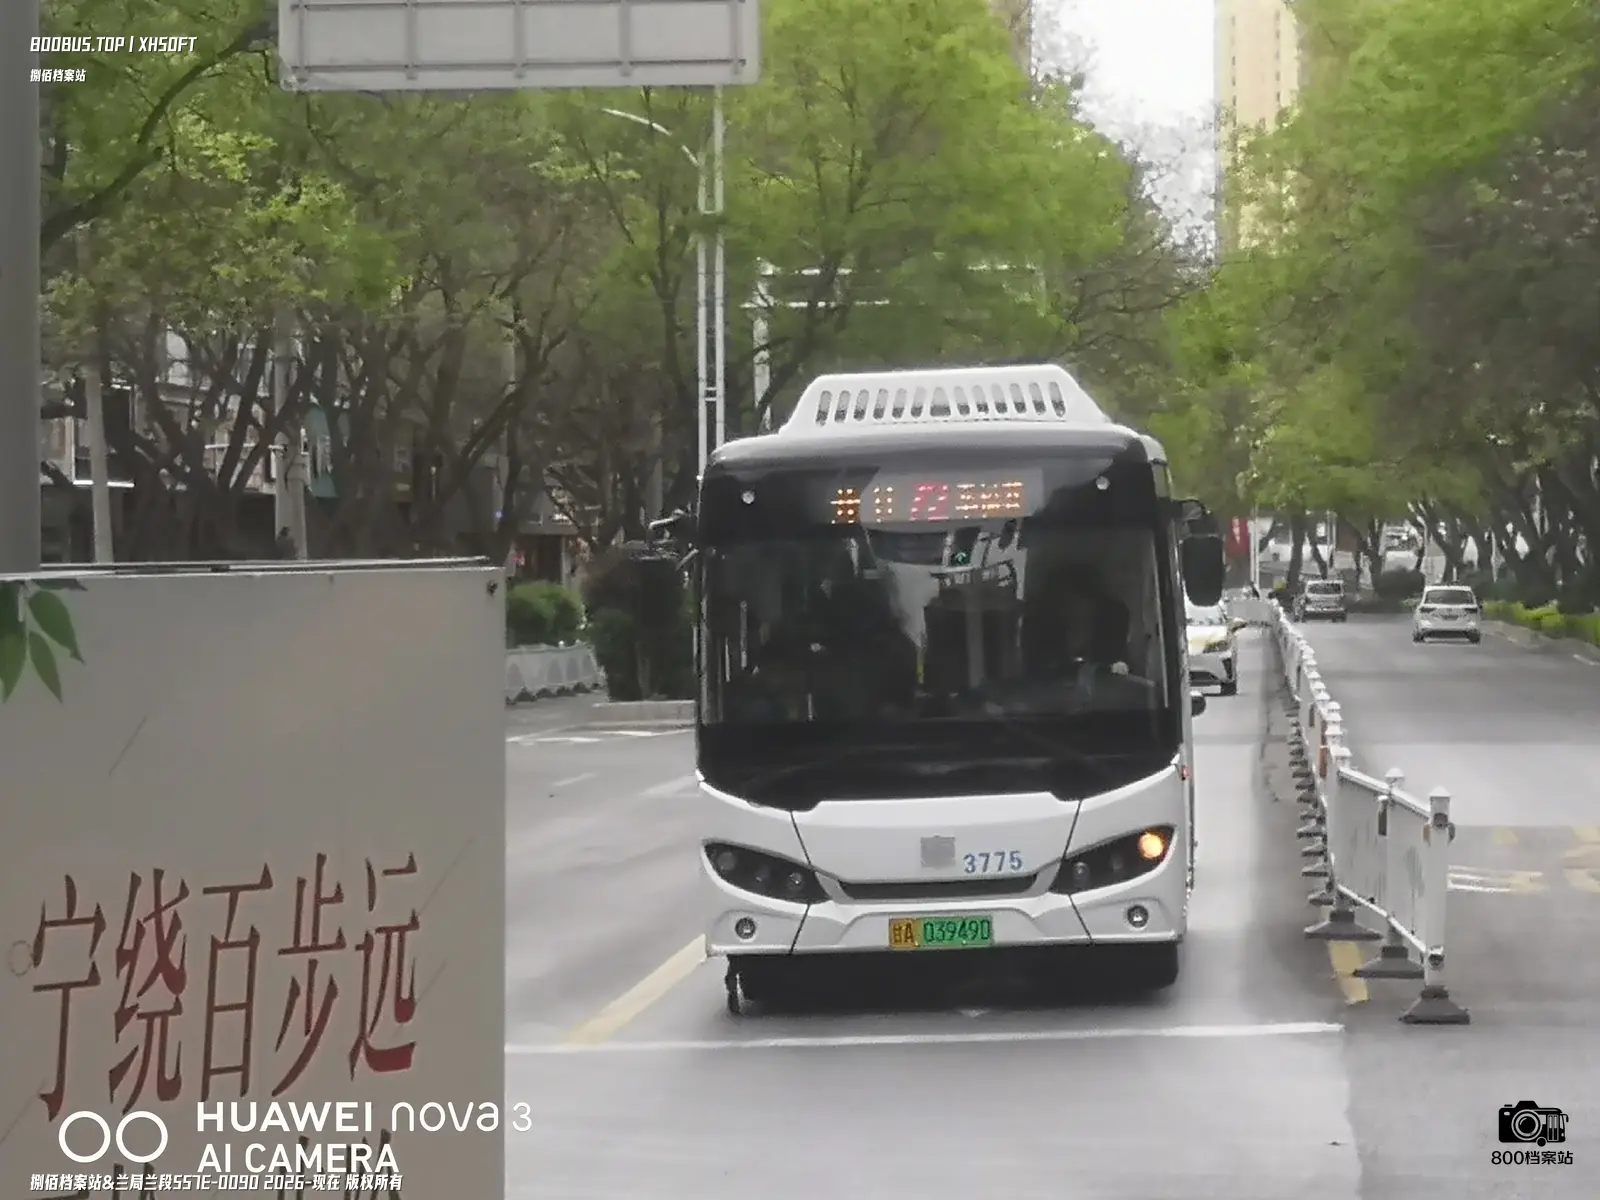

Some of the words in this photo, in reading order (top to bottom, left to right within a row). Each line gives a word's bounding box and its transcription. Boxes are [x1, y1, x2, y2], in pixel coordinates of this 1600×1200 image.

[963, 851, 1023, 873] 3775
[33, 852, 419, 1123] 宁绕百步远
